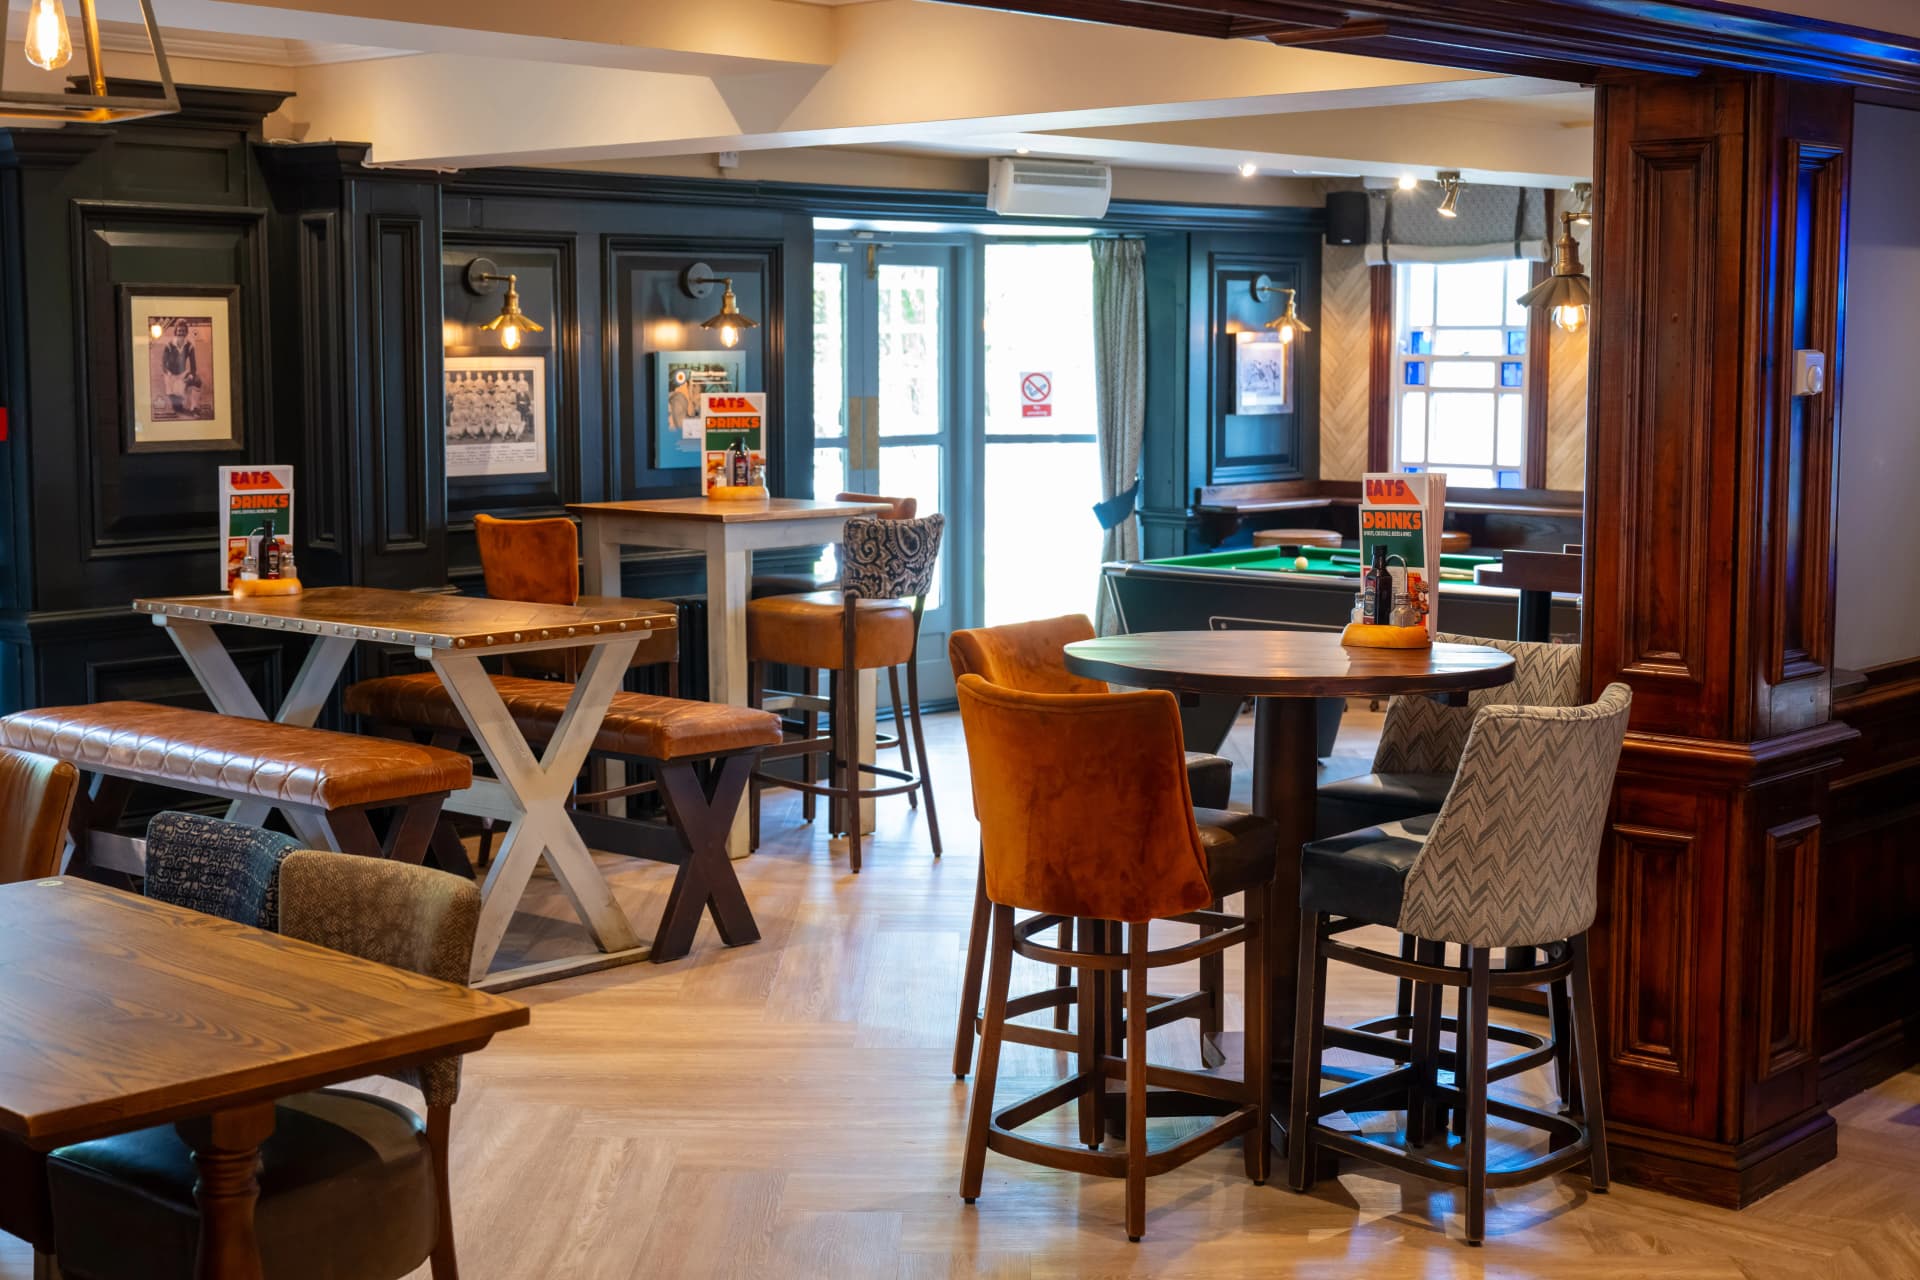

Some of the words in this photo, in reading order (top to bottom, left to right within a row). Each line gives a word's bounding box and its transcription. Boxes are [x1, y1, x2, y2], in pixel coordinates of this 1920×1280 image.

[708, 397, 745, 409] EATS
[706, 416, 760, 429] DRINKS
[230, 471, 271, 485] EATS
[1366, 479, 1405, 497] EATS
[231, 494, 289, 509] DRINKS
[1363, 511, 1421, 529] DRINKS
